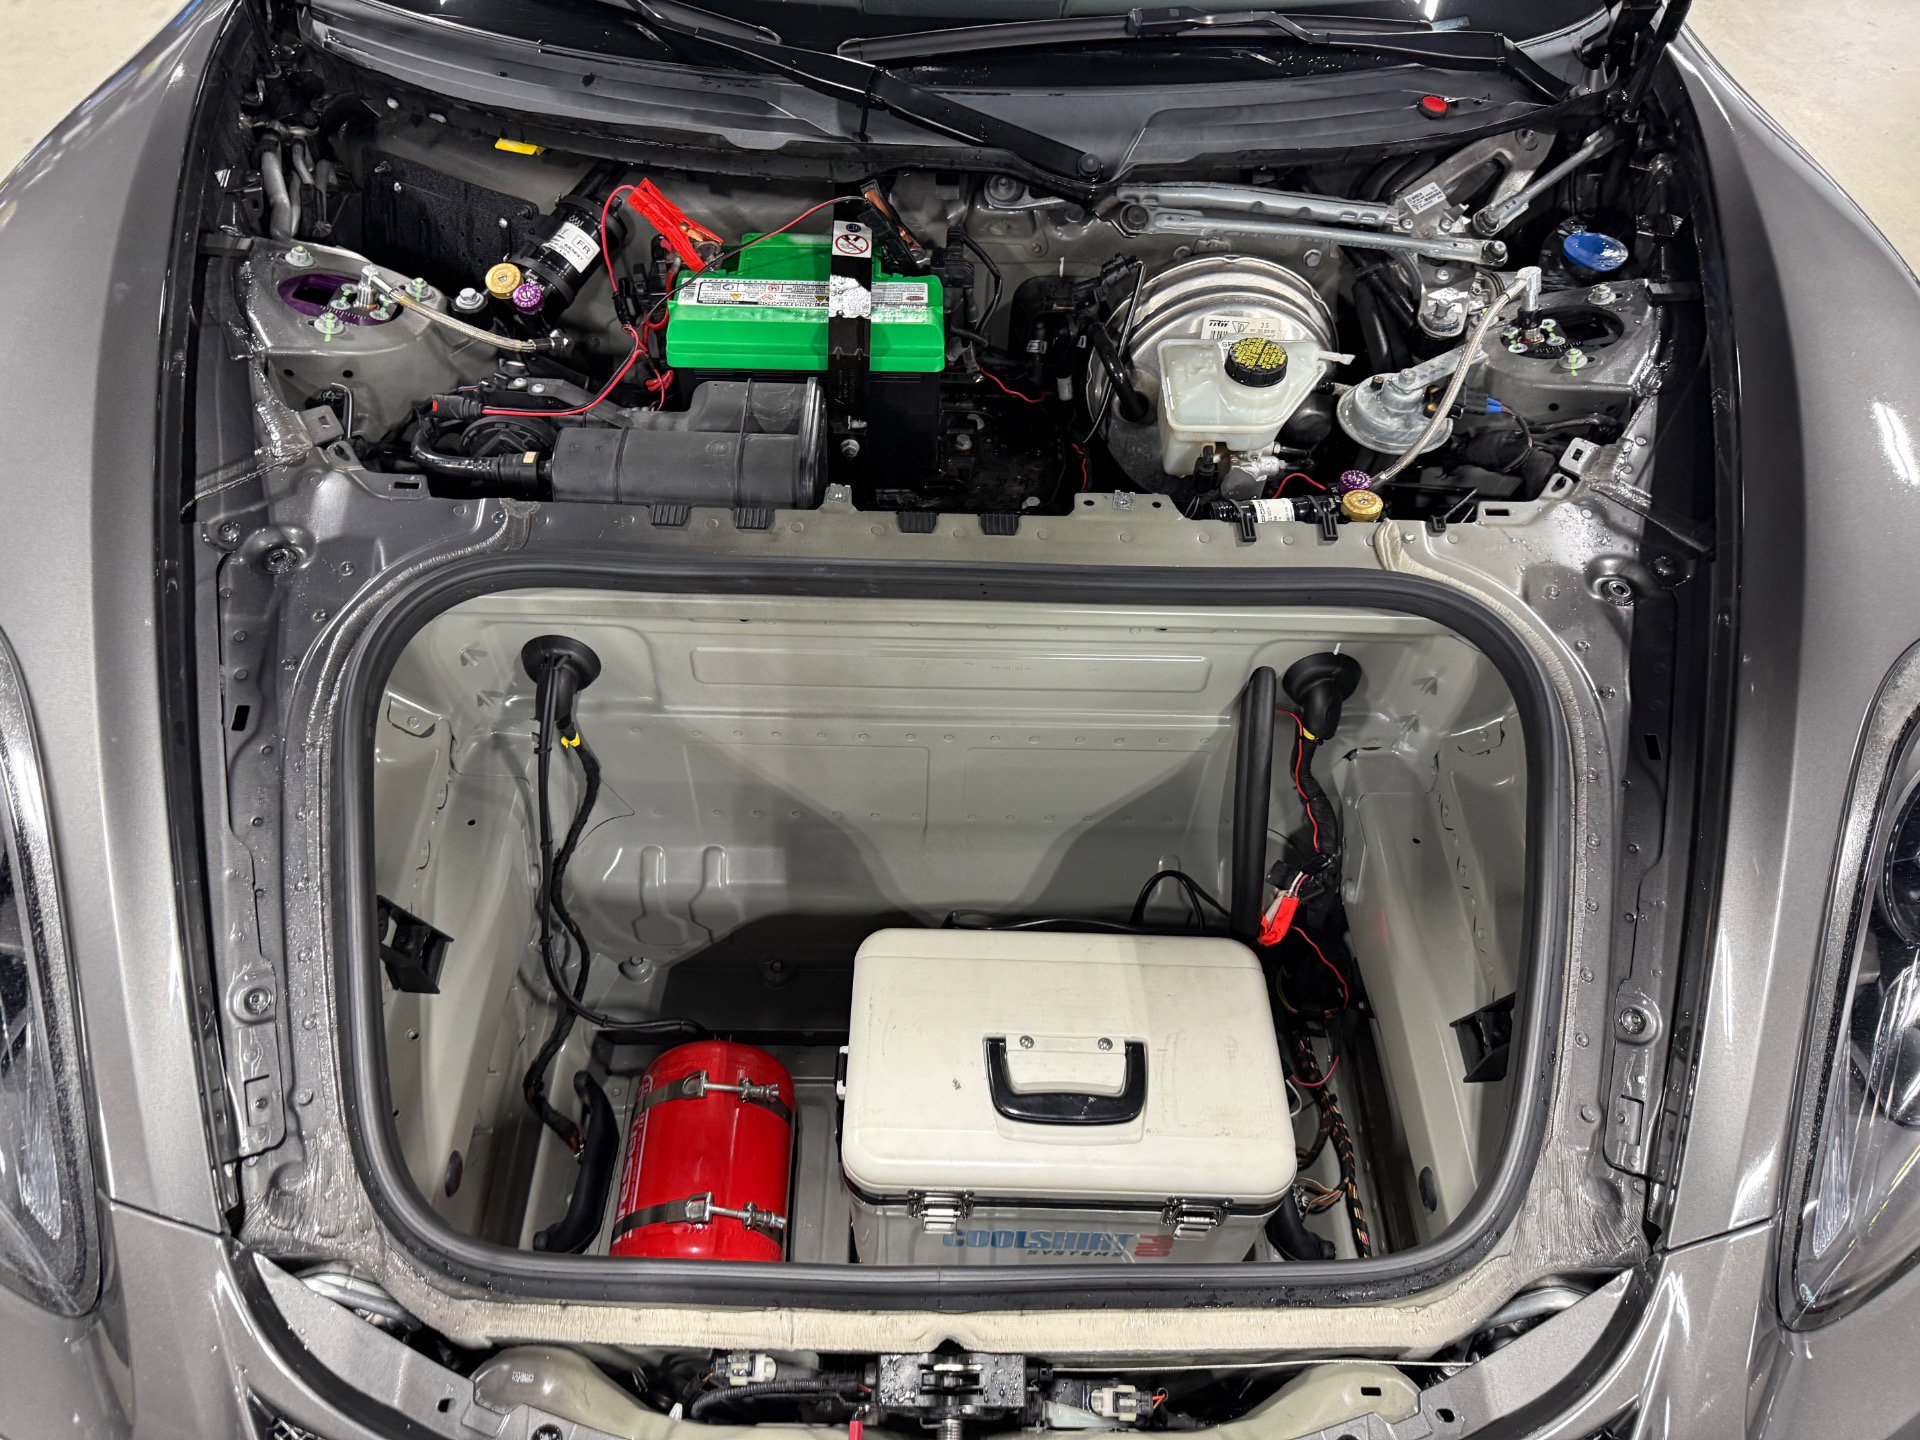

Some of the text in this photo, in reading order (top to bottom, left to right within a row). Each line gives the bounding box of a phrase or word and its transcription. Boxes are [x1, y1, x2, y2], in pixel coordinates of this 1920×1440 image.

[1208, 319, 1230, 328] TRW
[943, 1229, 1135, 1251] COOLSHIRT
[1026, 1249, 1123, 1258] SYSTEMS
